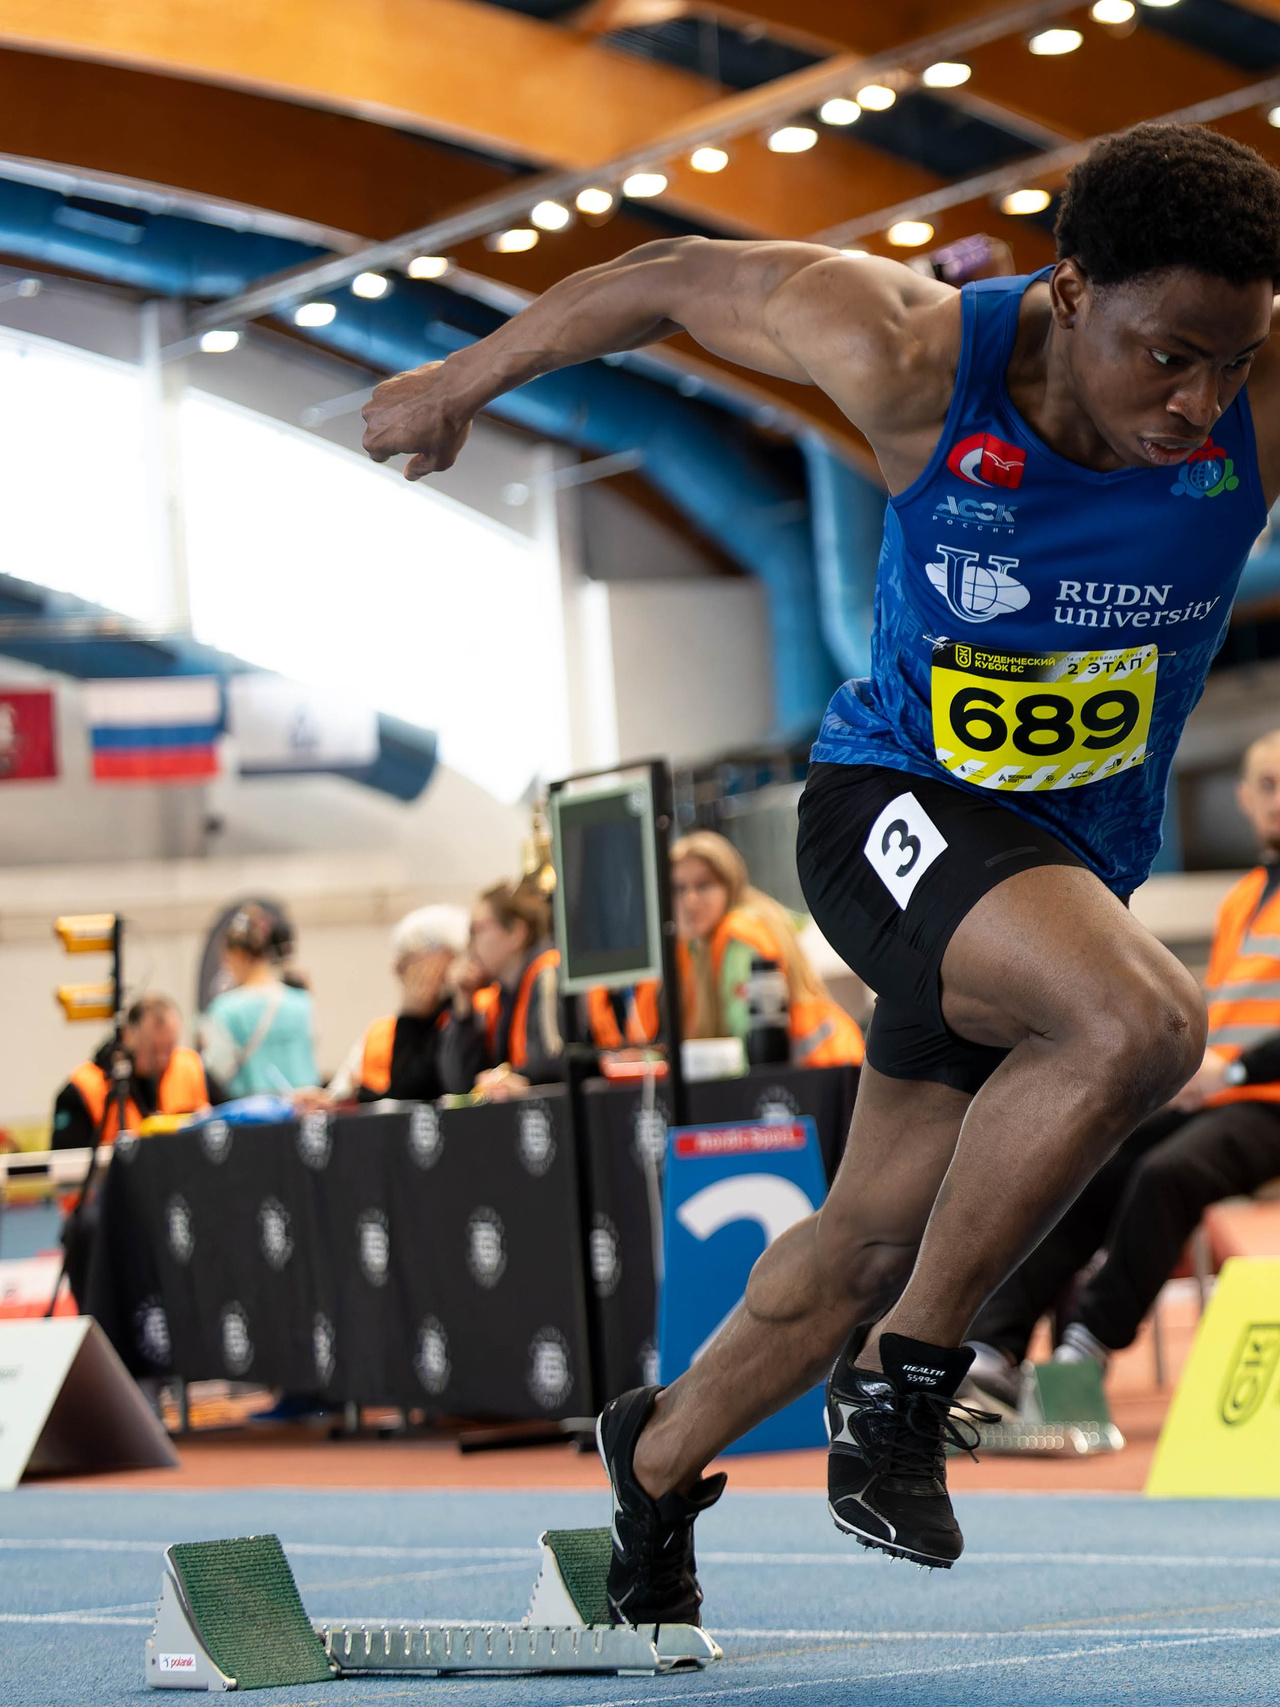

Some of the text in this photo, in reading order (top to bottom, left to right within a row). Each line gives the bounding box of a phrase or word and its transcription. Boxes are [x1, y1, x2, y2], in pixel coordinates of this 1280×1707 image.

[936, 495, 1018, 523] АССК
[932, 514, 1014, 535] РОССИИ
[1056, 580, 1173, 606] RUDN
[1054, 596, 1220, 628] university
[974, 652, 1056, 667] СТУДЕНЧЕСКИЙ
[974, 659, 1025, 673] КУБОК БС
[1067, 658, 1142, 675] 2 ЭТАП
[949, 687, 1140, 757] 689
[881, 818, 922, 878] 3
[902, 1364, 946, 1377] HEALTH
